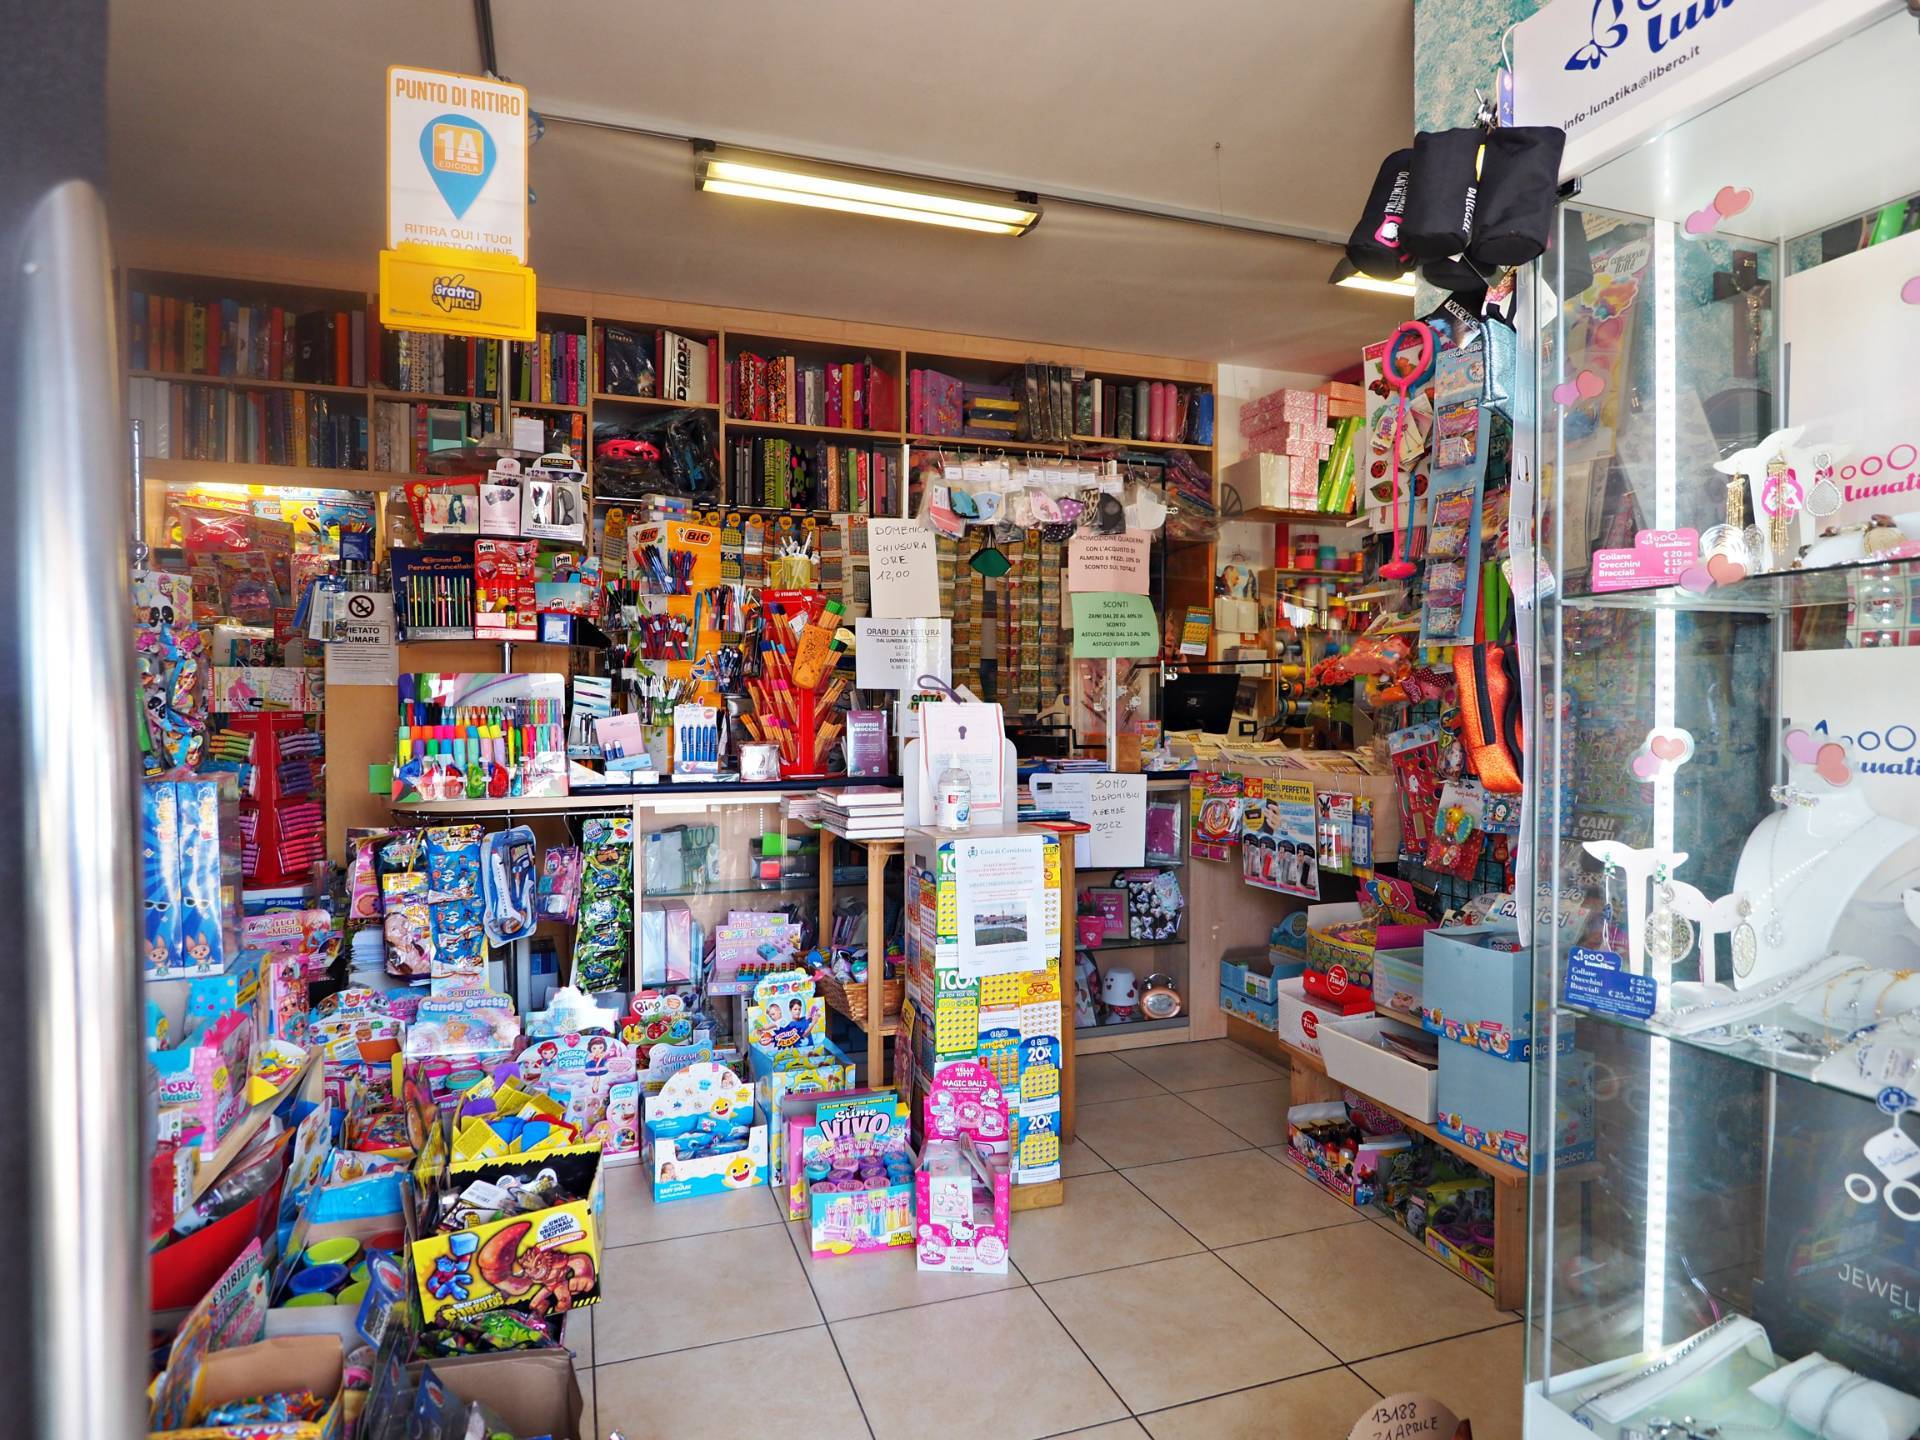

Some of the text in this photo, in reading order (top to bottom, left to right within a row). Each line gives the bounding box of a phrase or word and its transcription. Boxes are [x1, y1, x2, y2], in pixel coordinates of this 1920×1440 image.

[1563, 46, 1701, 130] info-lunatika@libero.it
[396, 78, 521, 116] PUNTO DI RITIRO
[439, 161, 480, 174] EDICOLA
[404, 223, 448, 239] RITIRA
[450, 228, 474, 246] QUI
[483, 233, 512, 245] TUOI
[433, 284, 476, 300] Gratta
[641, 530, 657, 541] BIC
[687, 531, 709, 542] BIC
[875, 525, 929, 537] DOMENICA
[875, 541, 927, 553] CHIUSURA
[556, 556, 570, 564] Pritt
[881, 554, 908, 566] ORE
[1599, 553, 1632, 561] Collane
[1599, 561, 1641, 569] Orecchini
[876, 569, 910, 584] 12,00
[1599, 569, 1635, 577] Bracciali
[866, 627, 899, 636] ORARI DI
[348, 636, 381, 644] UMARE
[911, 693, 943, 703] CITTÀ
[1095, 779, 1128, 790] SONO
[1281, 785, 1310, 794] PERFETTA
[1577, 815, 1616, 829] CANI
[1582, 828, 1615, 841] GATTI
[1571, 966, 1598, 978] Collane
[1570, 974, 1603, 988] Orecchini
[1570, 982, 1600, 994] Bracciali
[422, 997, 509, 1014] Candy Orsetti
[634, 1001, 661, 1014] Bing
[1028, 1046, 1052, 1062] 20X
[167, 1081, 196, 1093] CRY
[952, 1079, 987, 1087] MAGIC BALLS
[835, 1106, 877, 1122] Slime
[819, 1113, 891, 1142] VIVO
[1028, 1114, 1053, 1131] 20X
[1372, 1402, 1417, 1423] 13188
[1395, 1416, 1438, 1440] APRILE
